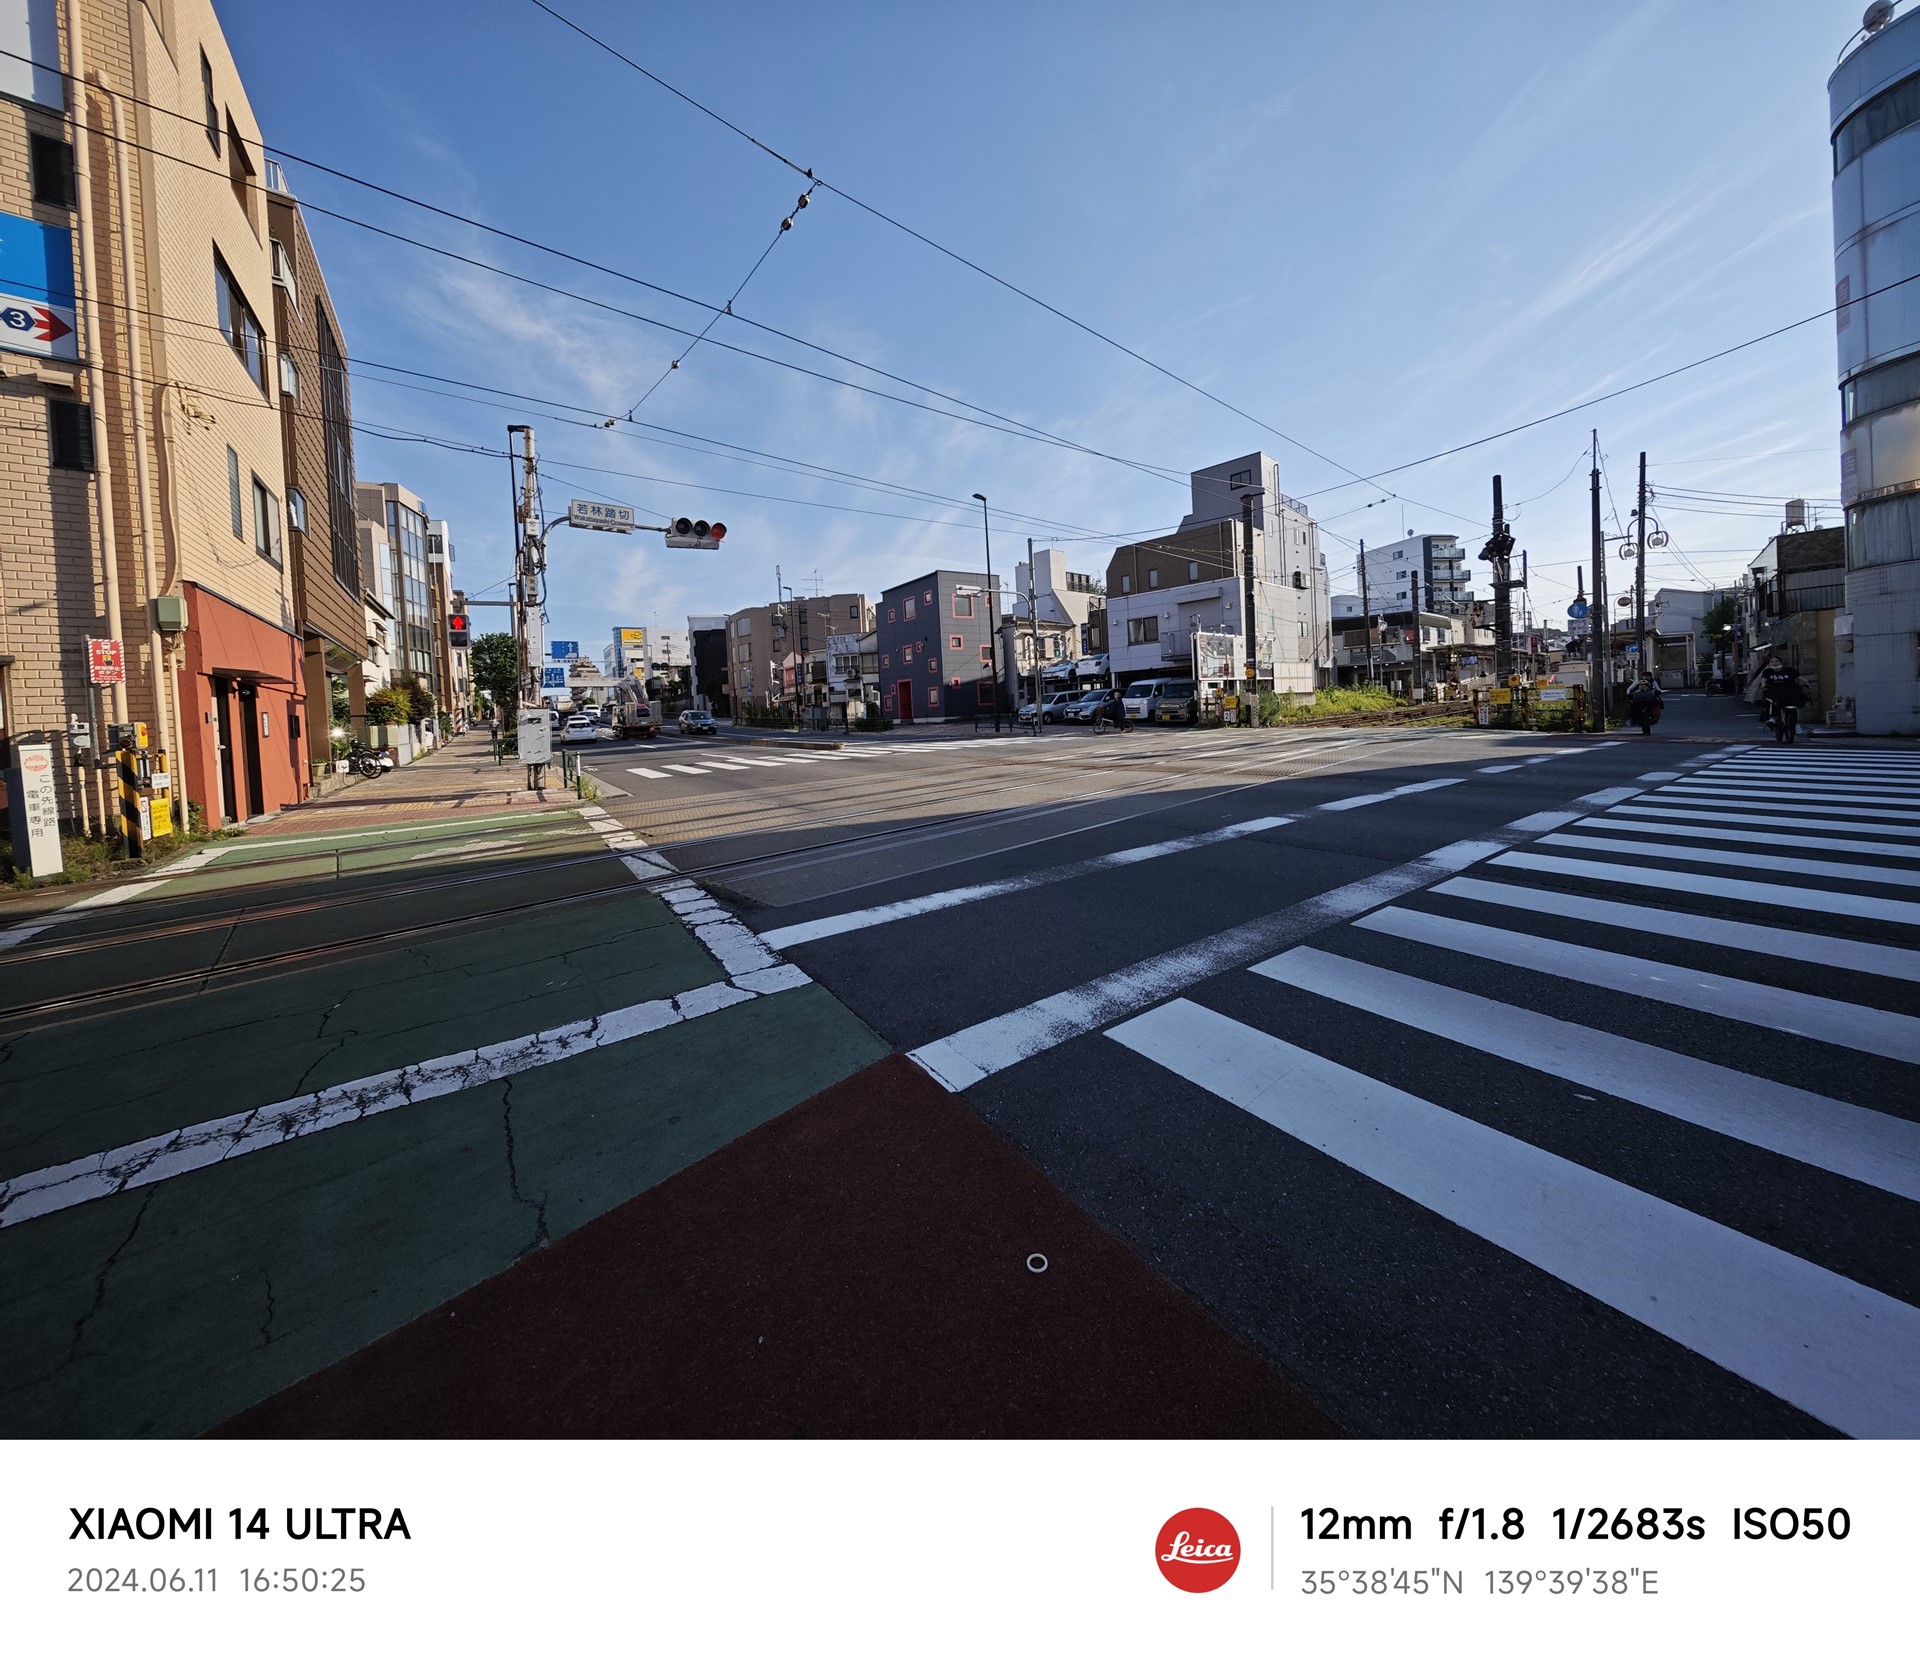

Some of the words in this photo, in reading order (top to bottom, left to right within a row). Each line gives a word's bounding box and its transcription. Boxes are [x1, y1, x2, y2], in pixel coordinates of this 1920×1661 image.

[10, 311, 26, 328] 3
[574, 514, 610, 524] Wakabayashi
[576, 503, 630, 521] 若林踏切
[39, 774, 56, 827] この先線路
[26, 789, 44, 838] 電車専用
